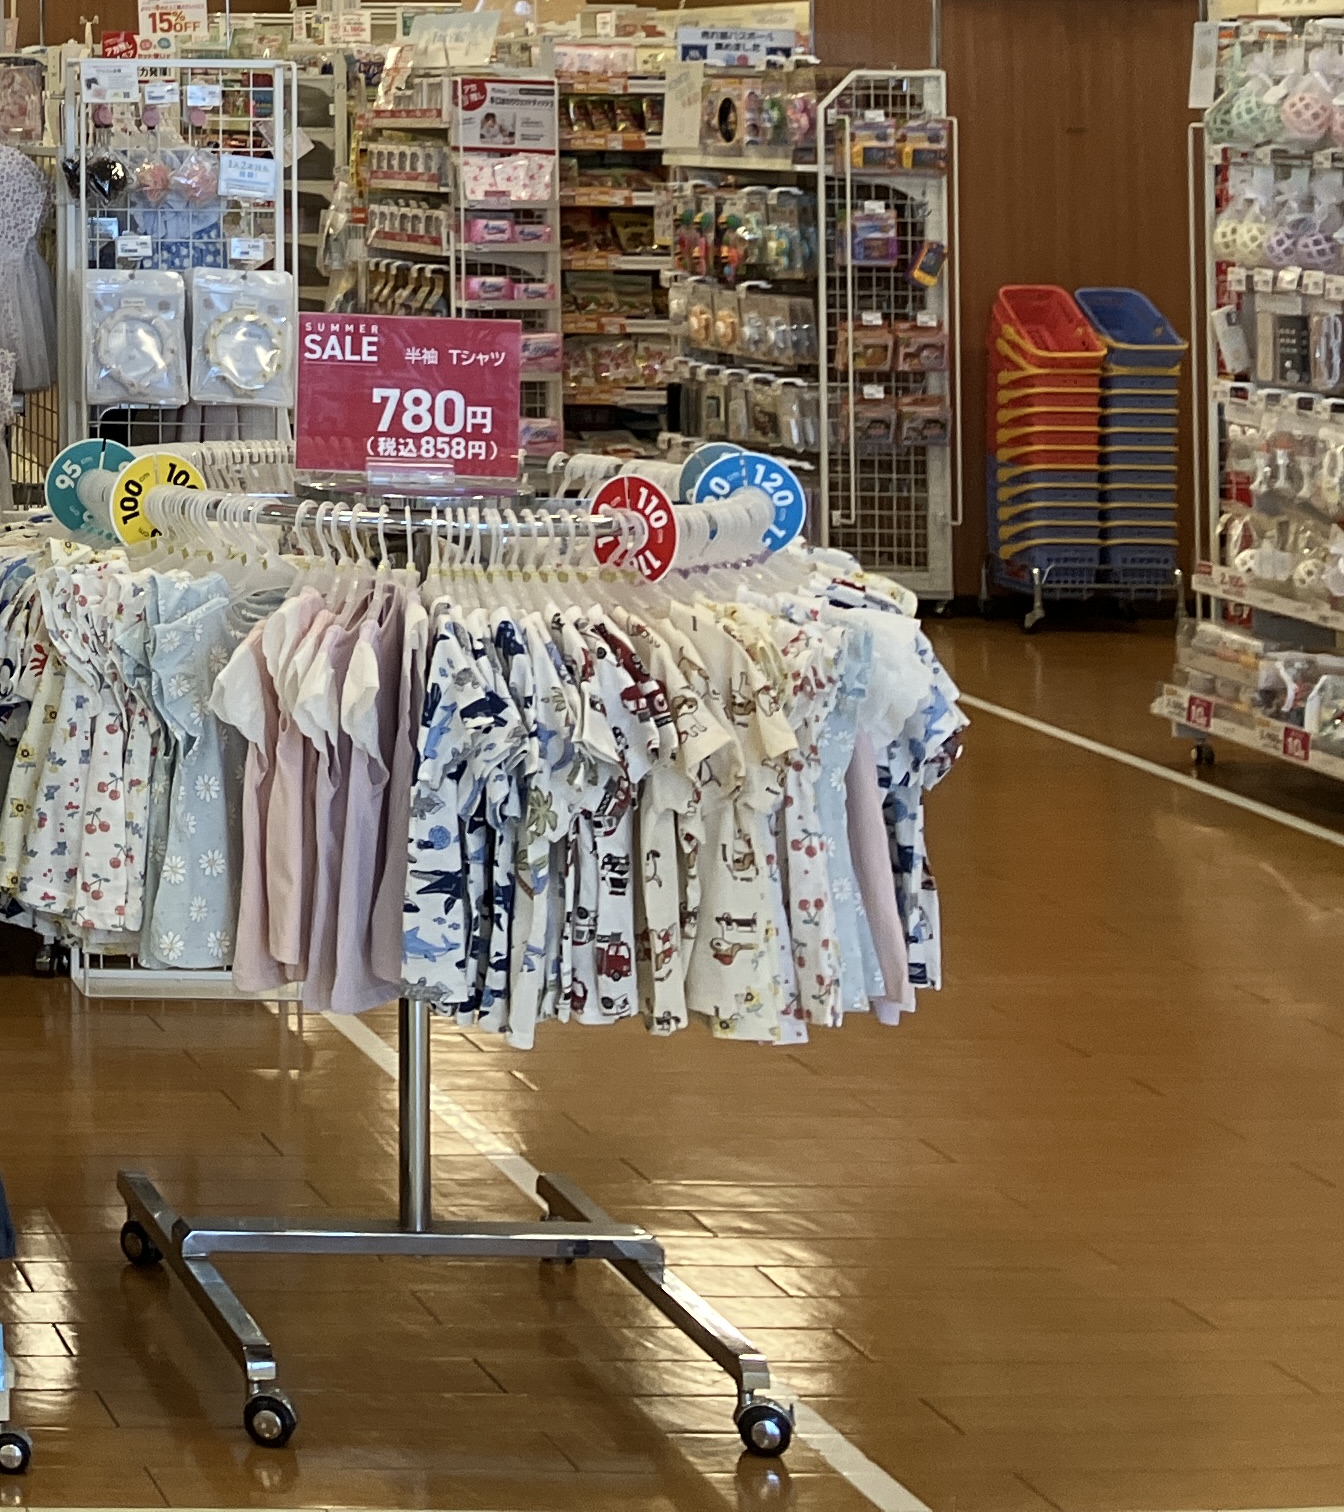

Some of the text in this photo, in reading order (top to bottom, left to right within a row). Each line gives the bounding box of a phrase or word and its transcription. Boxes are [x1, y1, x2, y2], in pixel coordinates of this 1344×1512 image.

[173, 21, 201, 33] OFF
[305, 321, 379, 335] SUMMER
[304, 333, 379, 362] SALE
[404, 346, 507, 367] 半袖 Tシャツ
[372, 387, 492, 435] 780円
[366, 435, 498, 461] (税込858円)
[55, 458, 82, 490] 95
[167, 462, 199, 489] 10
[754, 463, 795, 508] 120
[119, 479, 143, 525] 100
[637, 486, 668, 530] 110
